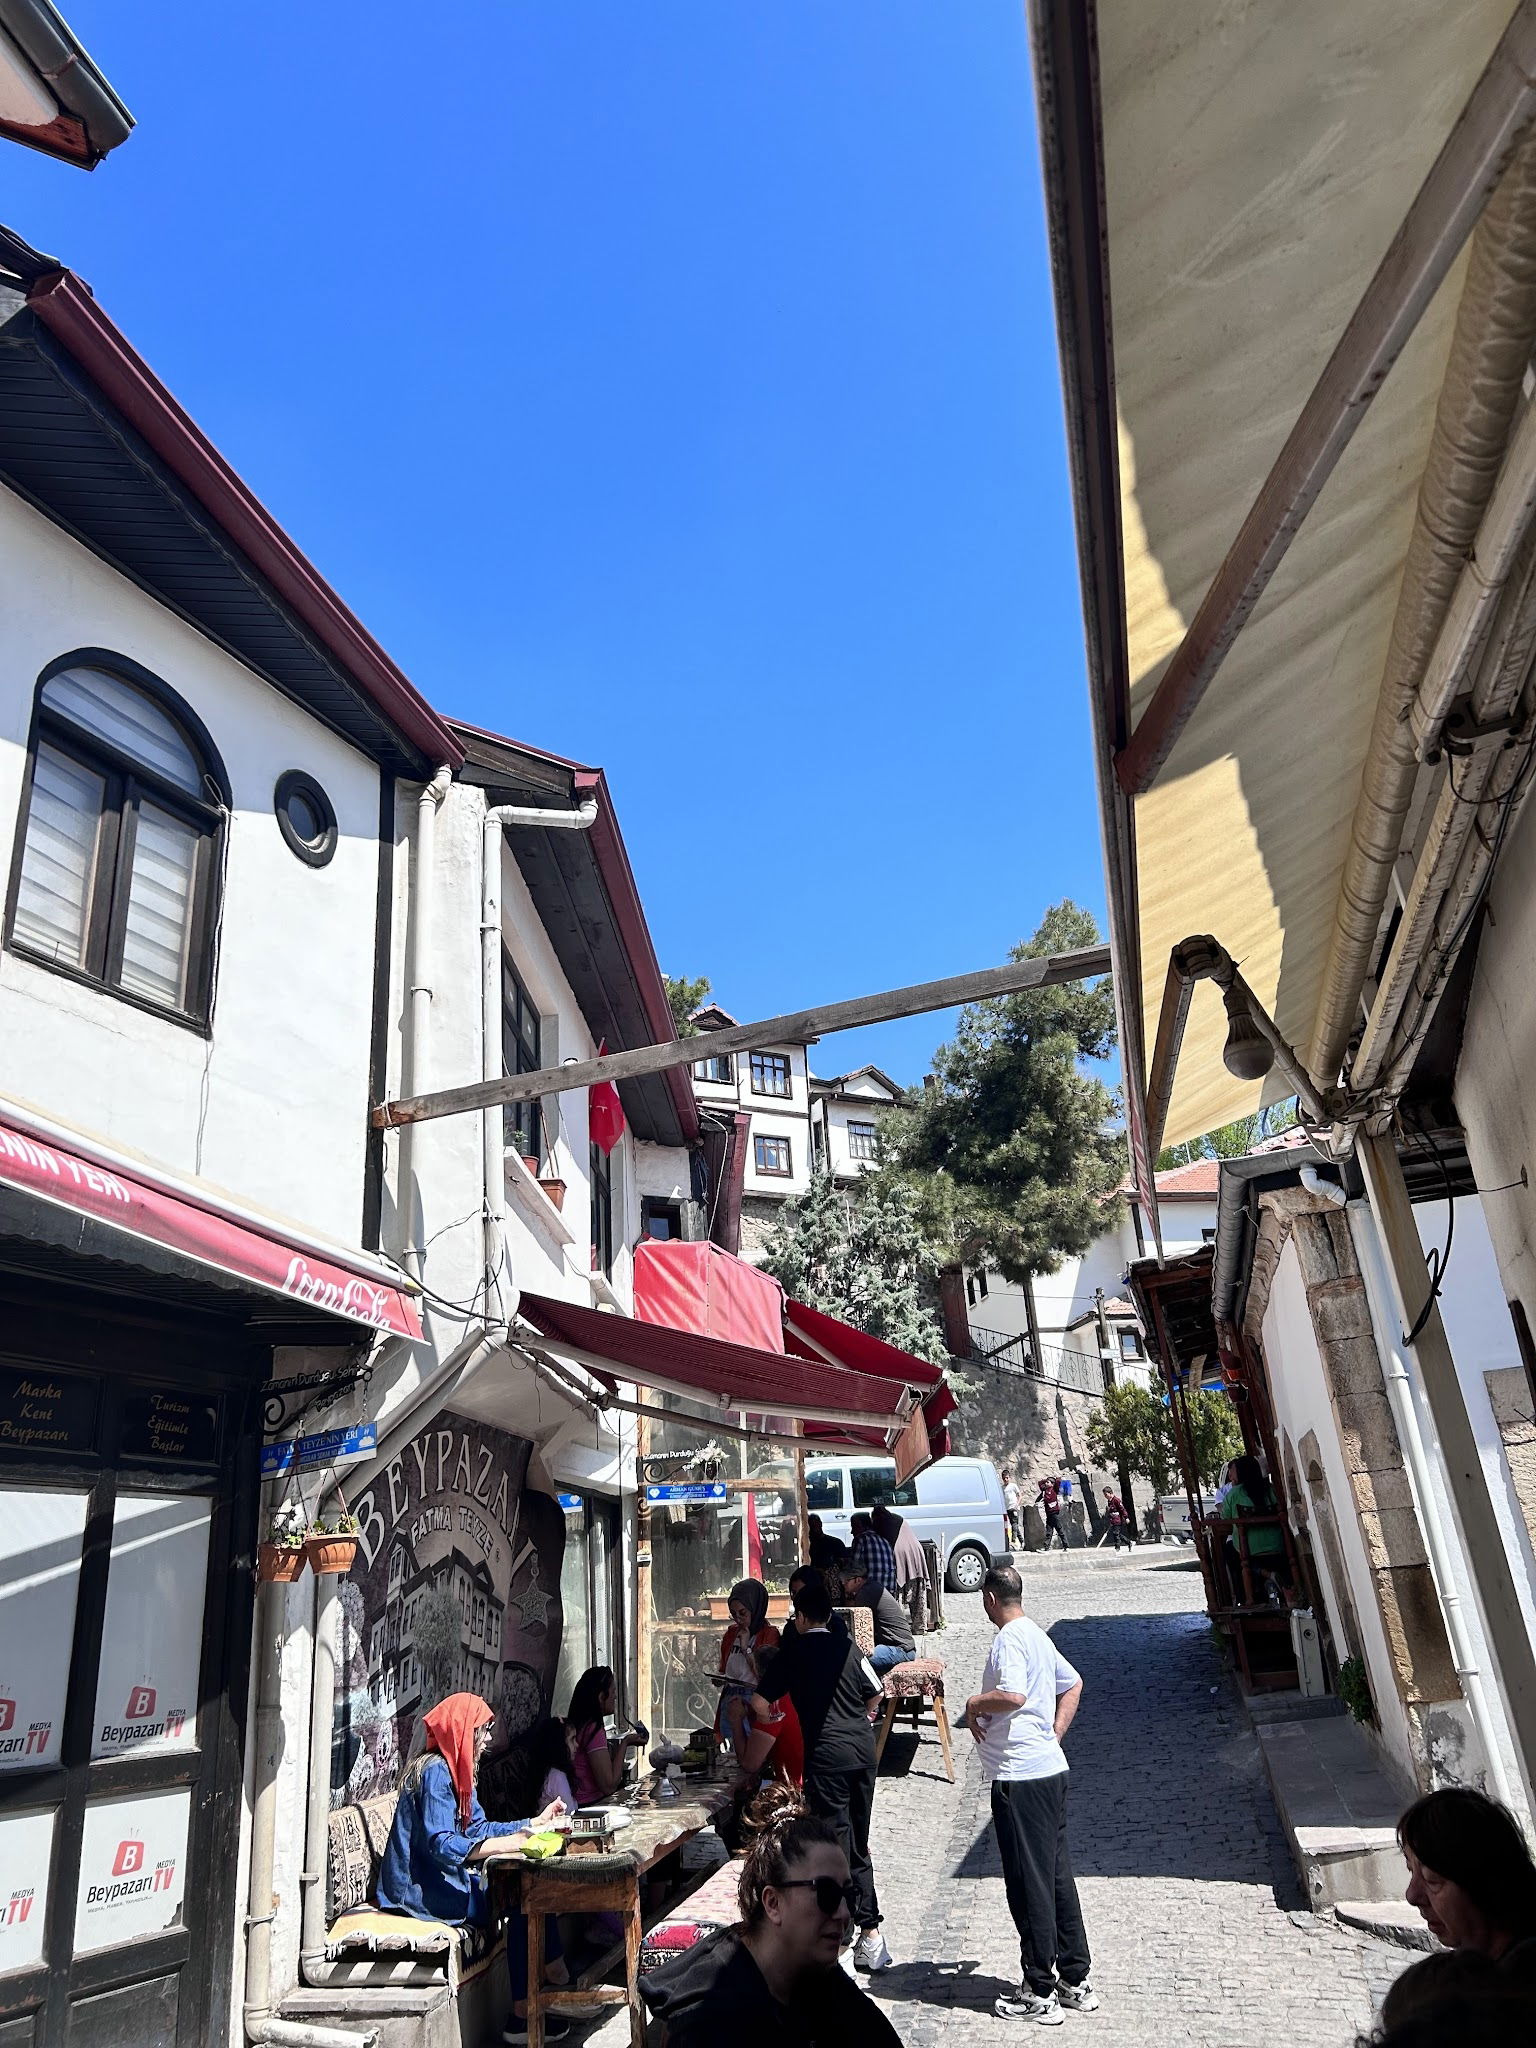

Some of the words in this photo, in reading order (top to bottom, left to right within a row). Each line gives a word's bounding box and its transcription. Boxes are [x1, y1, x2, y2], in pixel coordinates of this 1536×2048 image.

[12, 1380, 63, 1399] Marka
[20, 1403, 53, 1420] Kent
[150, 1394, 190, 1414] Turizm
[0, 1420, 69, 1443] Beypazarı
[147, 1415, 189, 1434] Eğitimle
[150, 1435, 185, 1454] Başlar
[411, 1506, 452, 1550] FATMA
[459, 1506, 494, 1560] TEYZE
[134, 1691, 150, 1715] B
[167, 1709, 186, 1717] MEDYA
[29, 1721, 52, 1731] MEDYA
[101, 1722, 164, 1743] Beypazarı
[164, 1716, 185, 1738] TV
[25, 1729, 50, 1755] TV
[121, 1845, 138, 1870] B
[156, 1859, 176, 1869] MEDYA
[11, 1888, 35, 1899] MEDYA
[86, 1876, 153, 1904] Beypazarı
[153, 1867, 175, 1892] TV
[7, 1896, 34, 1925] TV
